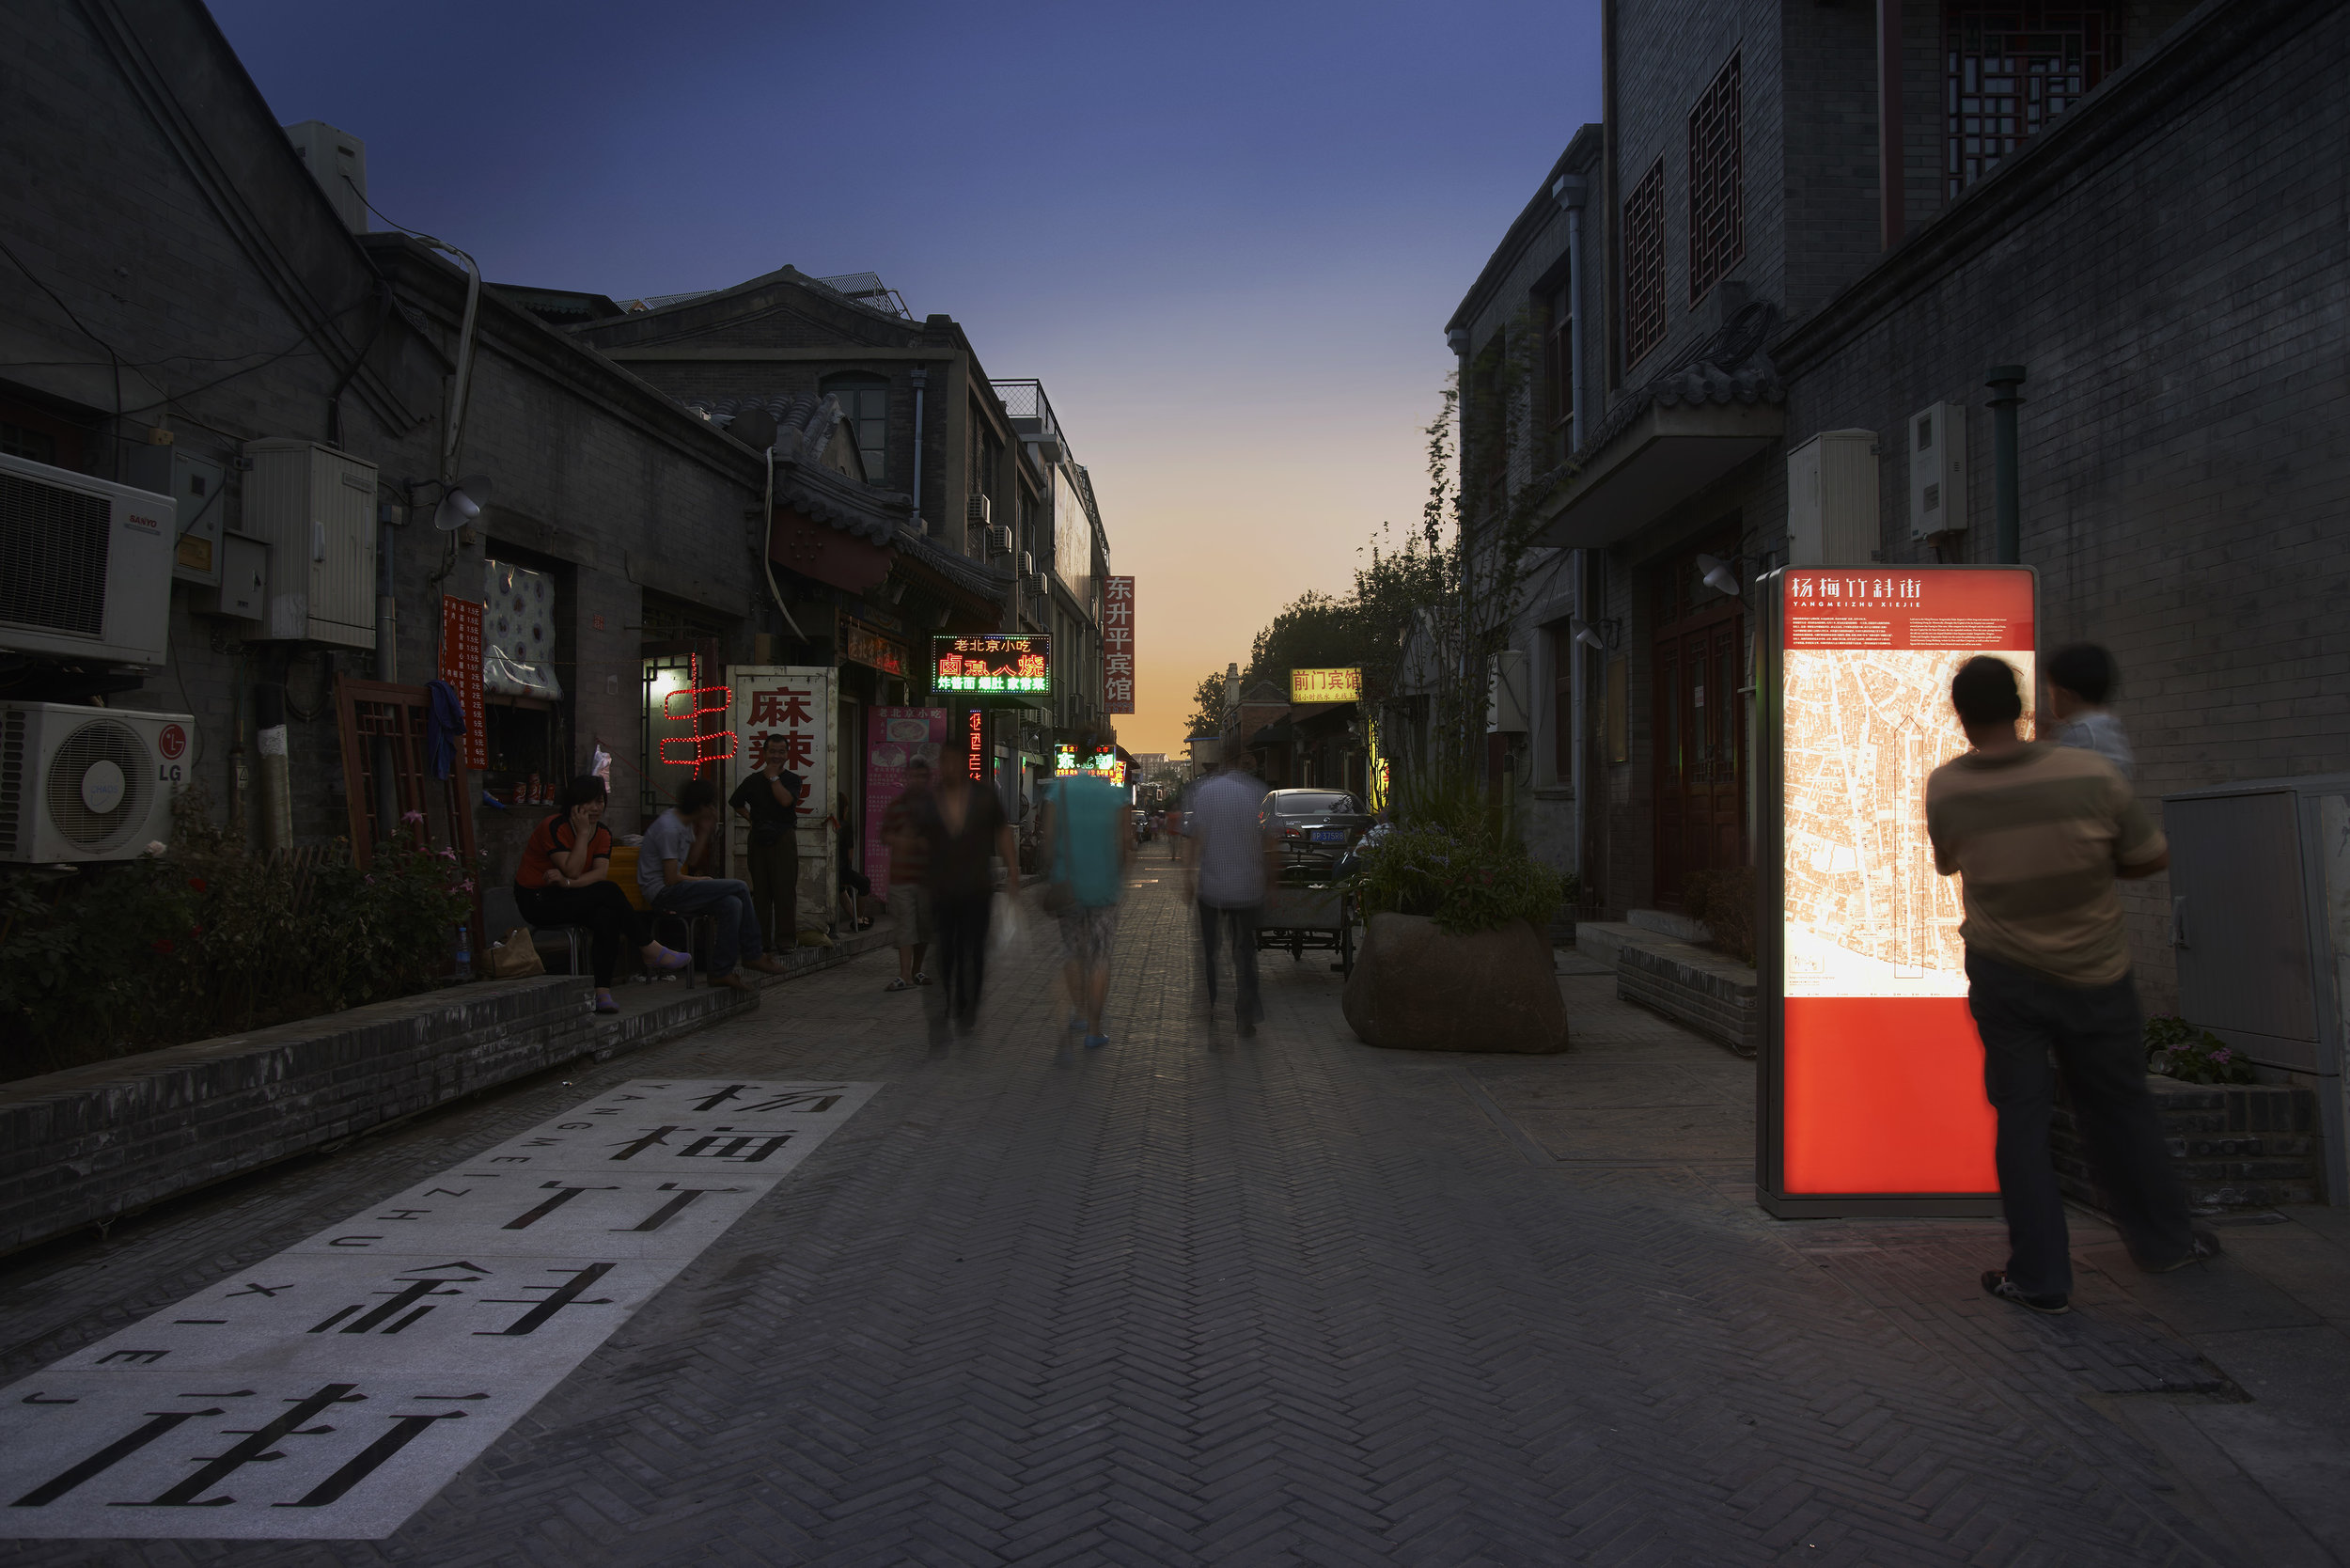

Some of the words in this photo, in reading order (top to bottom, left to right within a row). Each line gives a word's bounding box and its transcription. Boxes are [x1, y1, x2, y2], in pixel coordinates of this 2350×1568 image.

[129, 514, 157, 528] SANYO
[1791, 577, 1922, 598] 杨梅竹斜街
[954, 639, 1031, 652] 老北京小吃
[1104, 576, 1133, 701] 东升平宾馆
[1007, 676, 1046, 691] 家常菜
[1292, 669, 1361, 691] 前门宾馆
[1293, 692, 1330, 701] 24小时热水
[878, 708, 942, 719] 老北京小吃
[747, 686, 815, 814] 麻辣
[159, 764, 181, 781] LG
[90, 785, 119, 794] CHAOS
